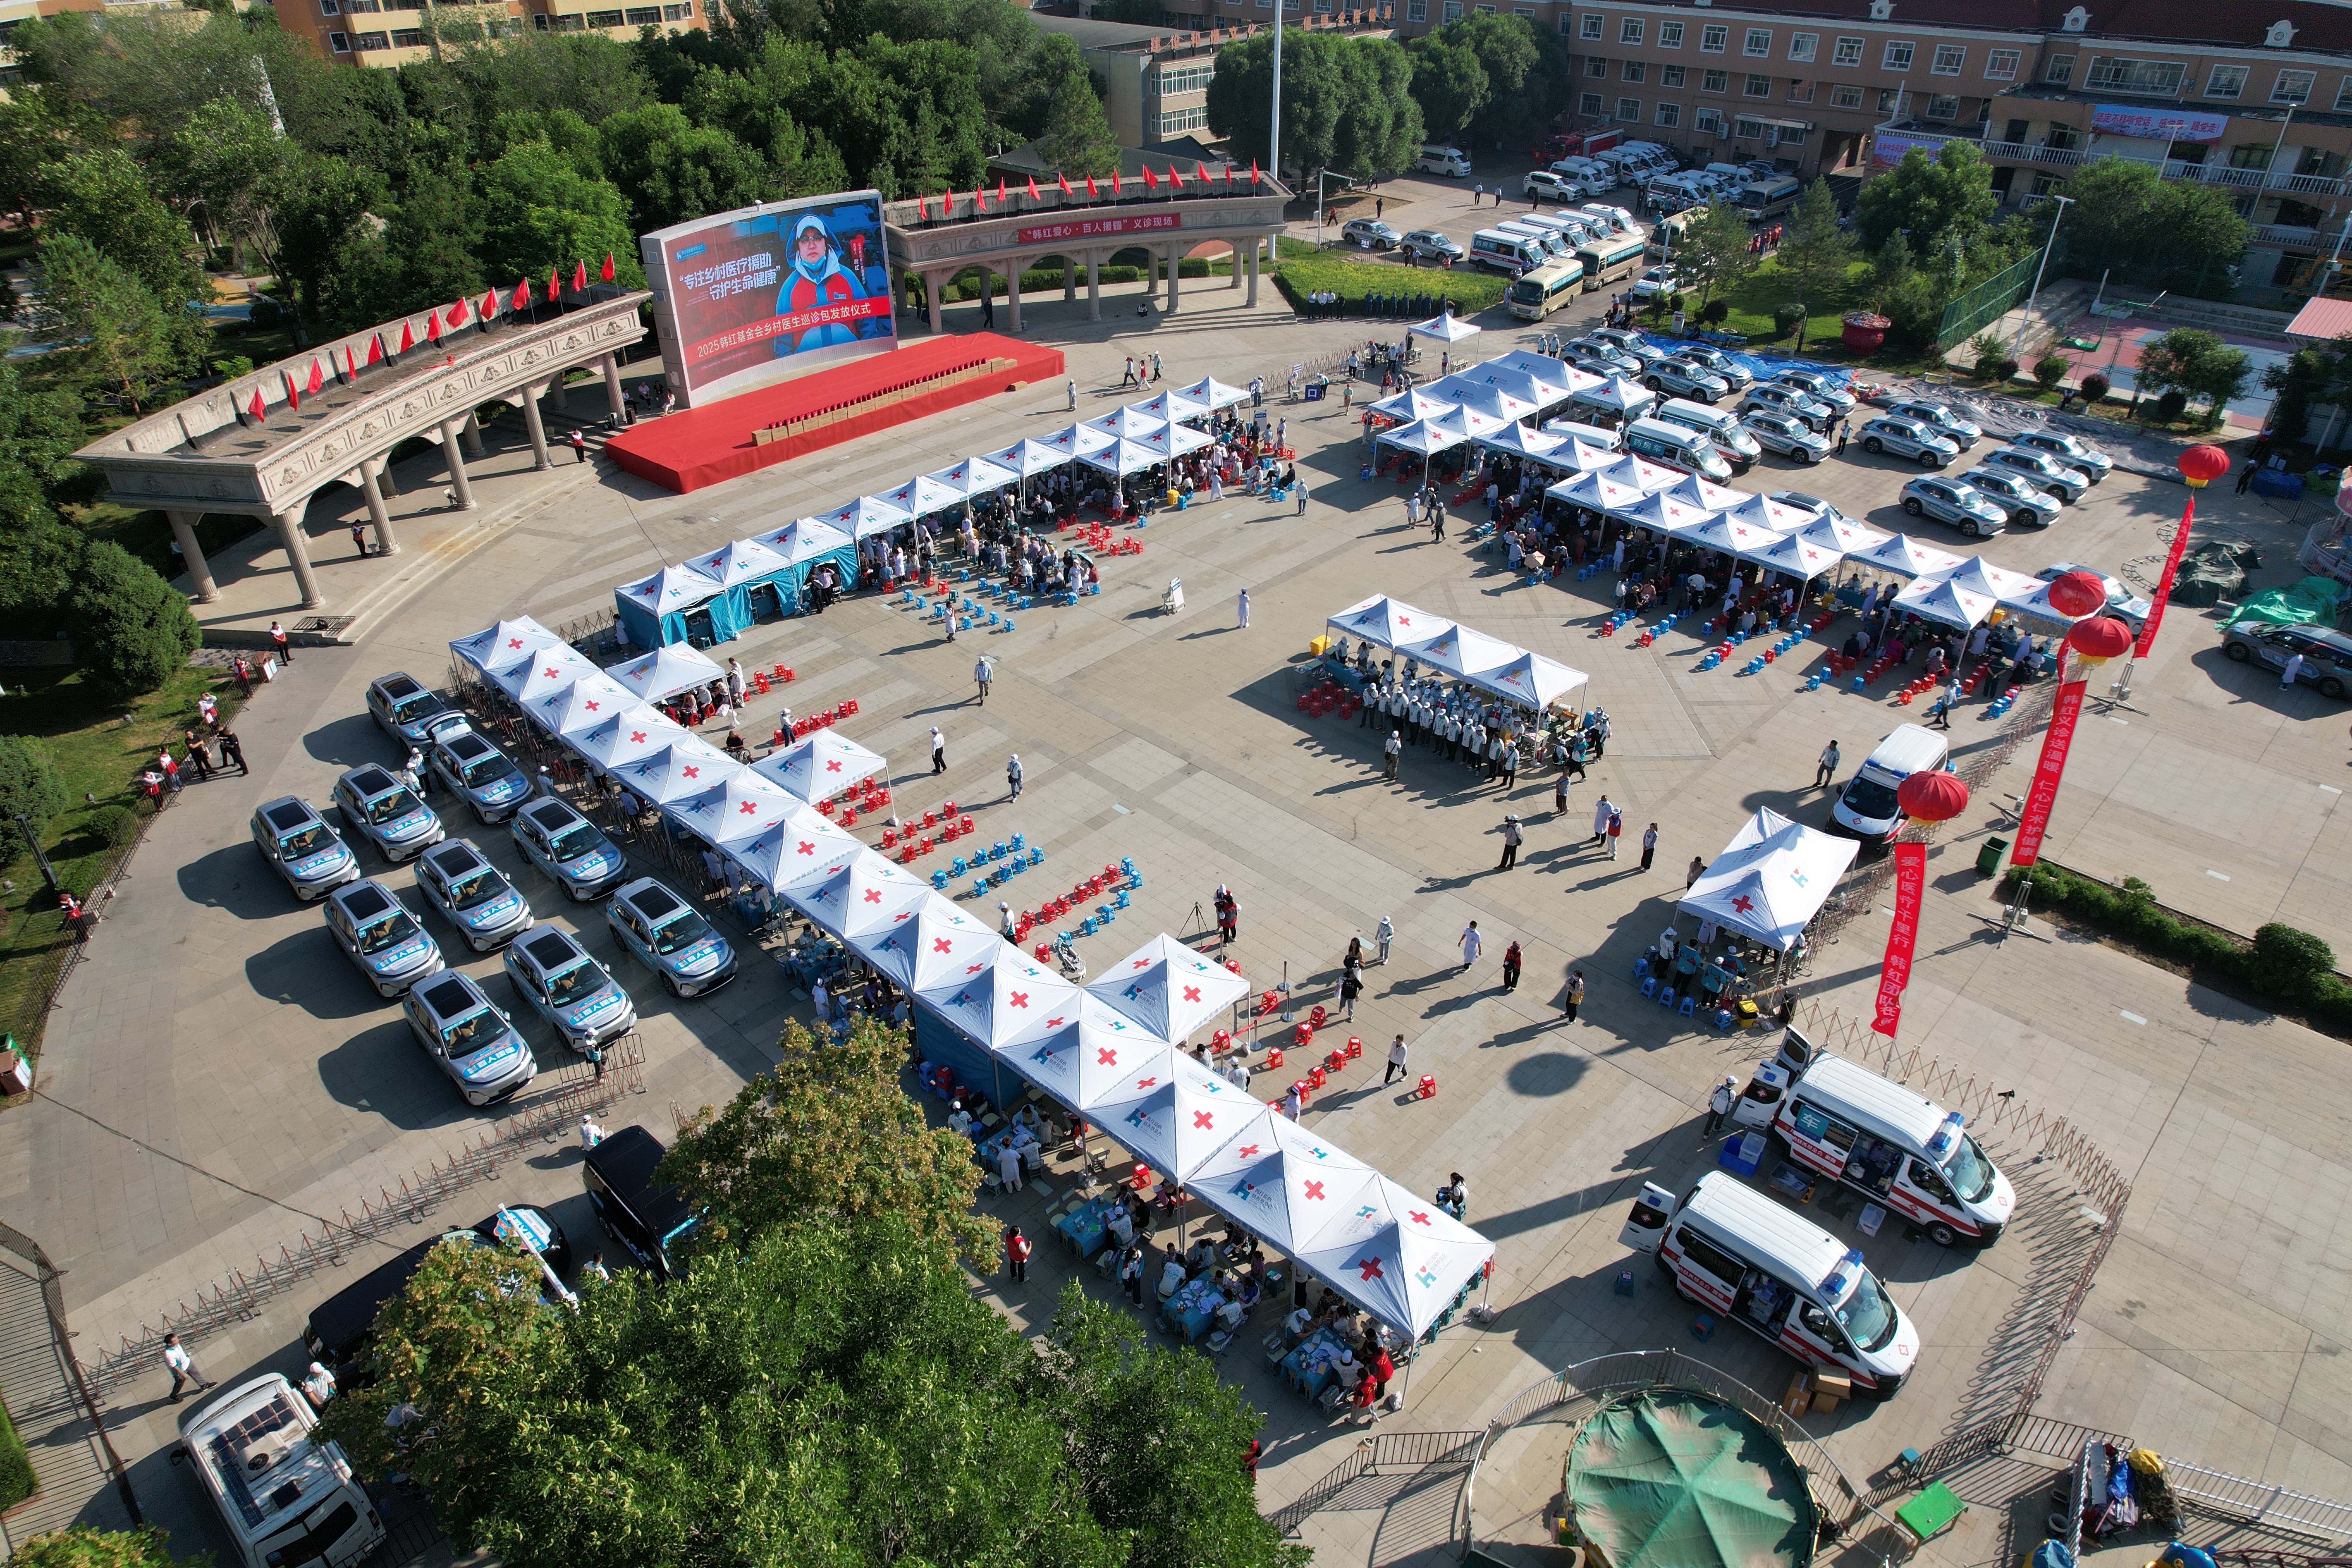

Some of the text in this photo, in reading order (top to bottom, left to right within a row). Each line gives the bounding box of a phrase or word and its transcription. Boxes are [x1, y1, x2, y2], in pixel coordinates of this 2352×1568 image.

[1133, 216, 1173, 230] 义诊现场
[679, 252, 772, 290] “专注乡村医疗援助
[709, 266, 781, 300] 守护生命健康”
[698, 302, 871, 358] 2025韩红基金会乡村医生巡诊包发放仪式
[1633, 438, 1662, 452] 药房车
[2043, 694, 2079, 774] 韩红义诊送温暖
[1892, 856, 1920, 949] 爱心医疗千里行
[1713, 917, 1749, 936] 义诊入口
[1801, 1113, 1821, 1129] 车
